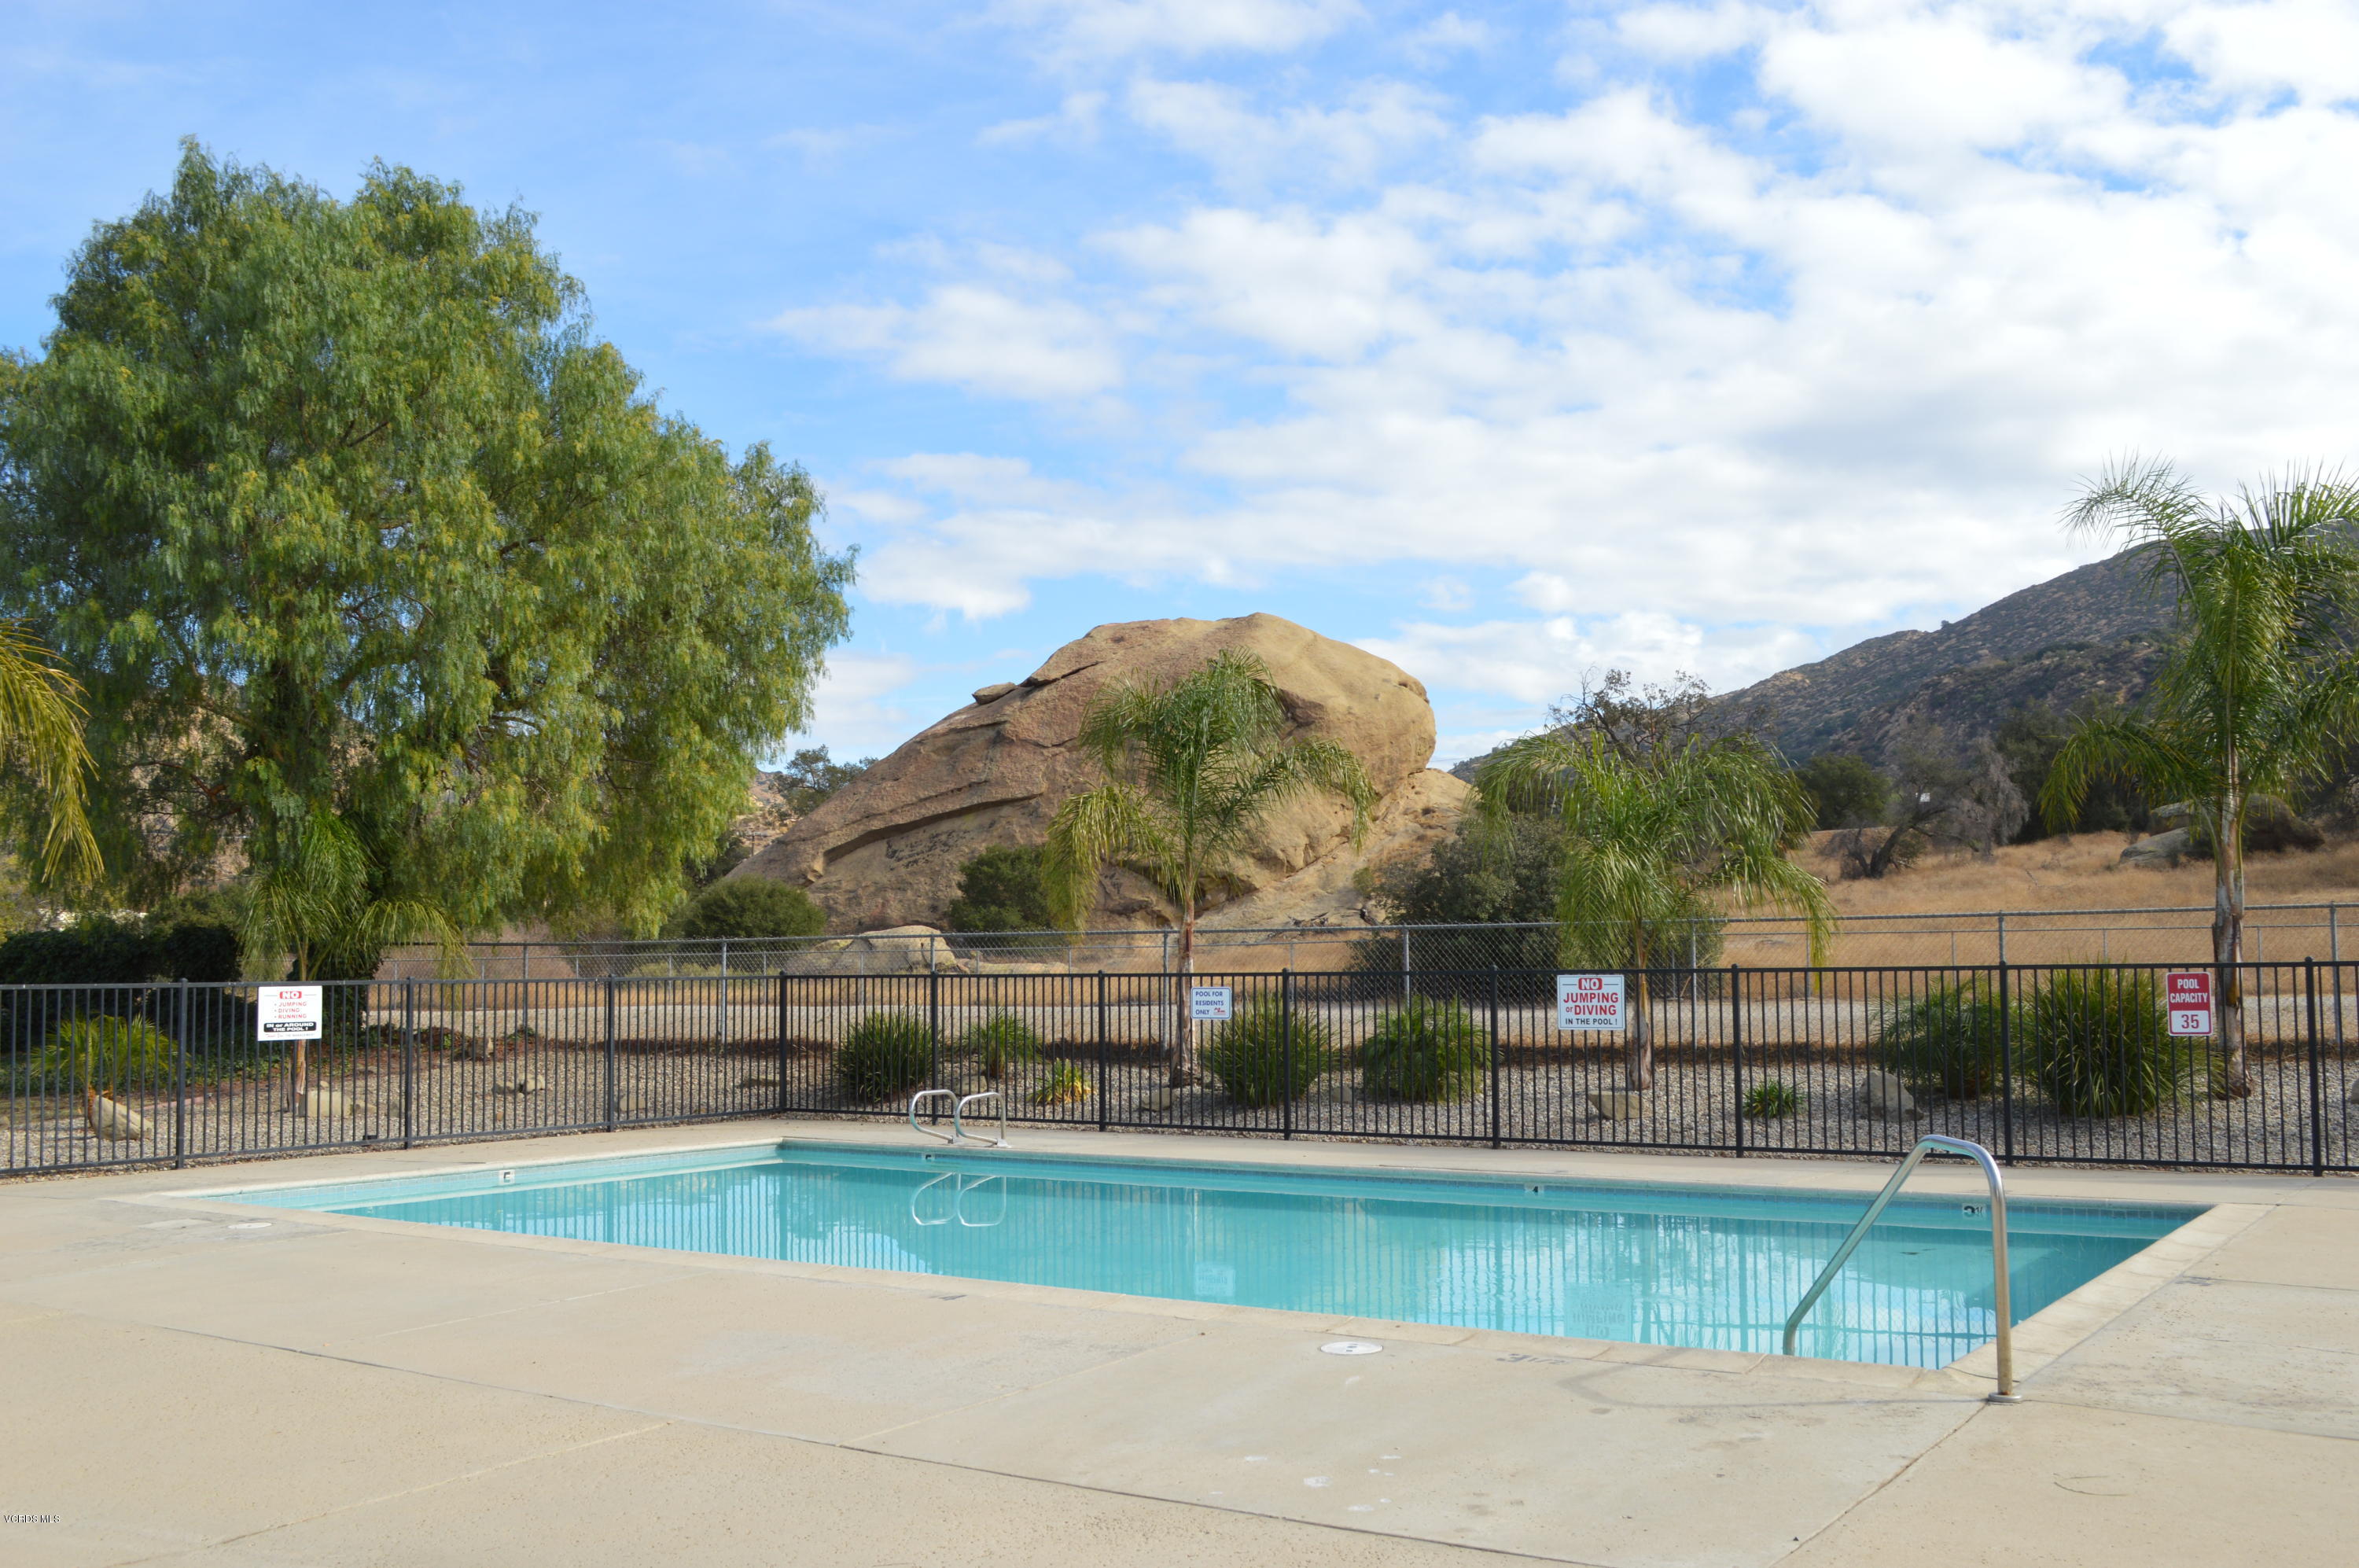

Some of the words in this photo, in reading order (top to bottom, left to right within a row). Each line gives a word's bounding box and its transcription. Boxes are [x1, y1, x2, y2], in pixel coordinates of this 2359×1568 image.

[1581, 978, 1599, 990] NO
[2177, 979, 2199, 989] POOL
[1563, 992, 1618, 1003] JUMPING
[2169, 992, 2208, 1003] CAPACITY
[1574, 1005, 1617, 1015] DIVING
[2181, 1014, 2199, 1029] 35
